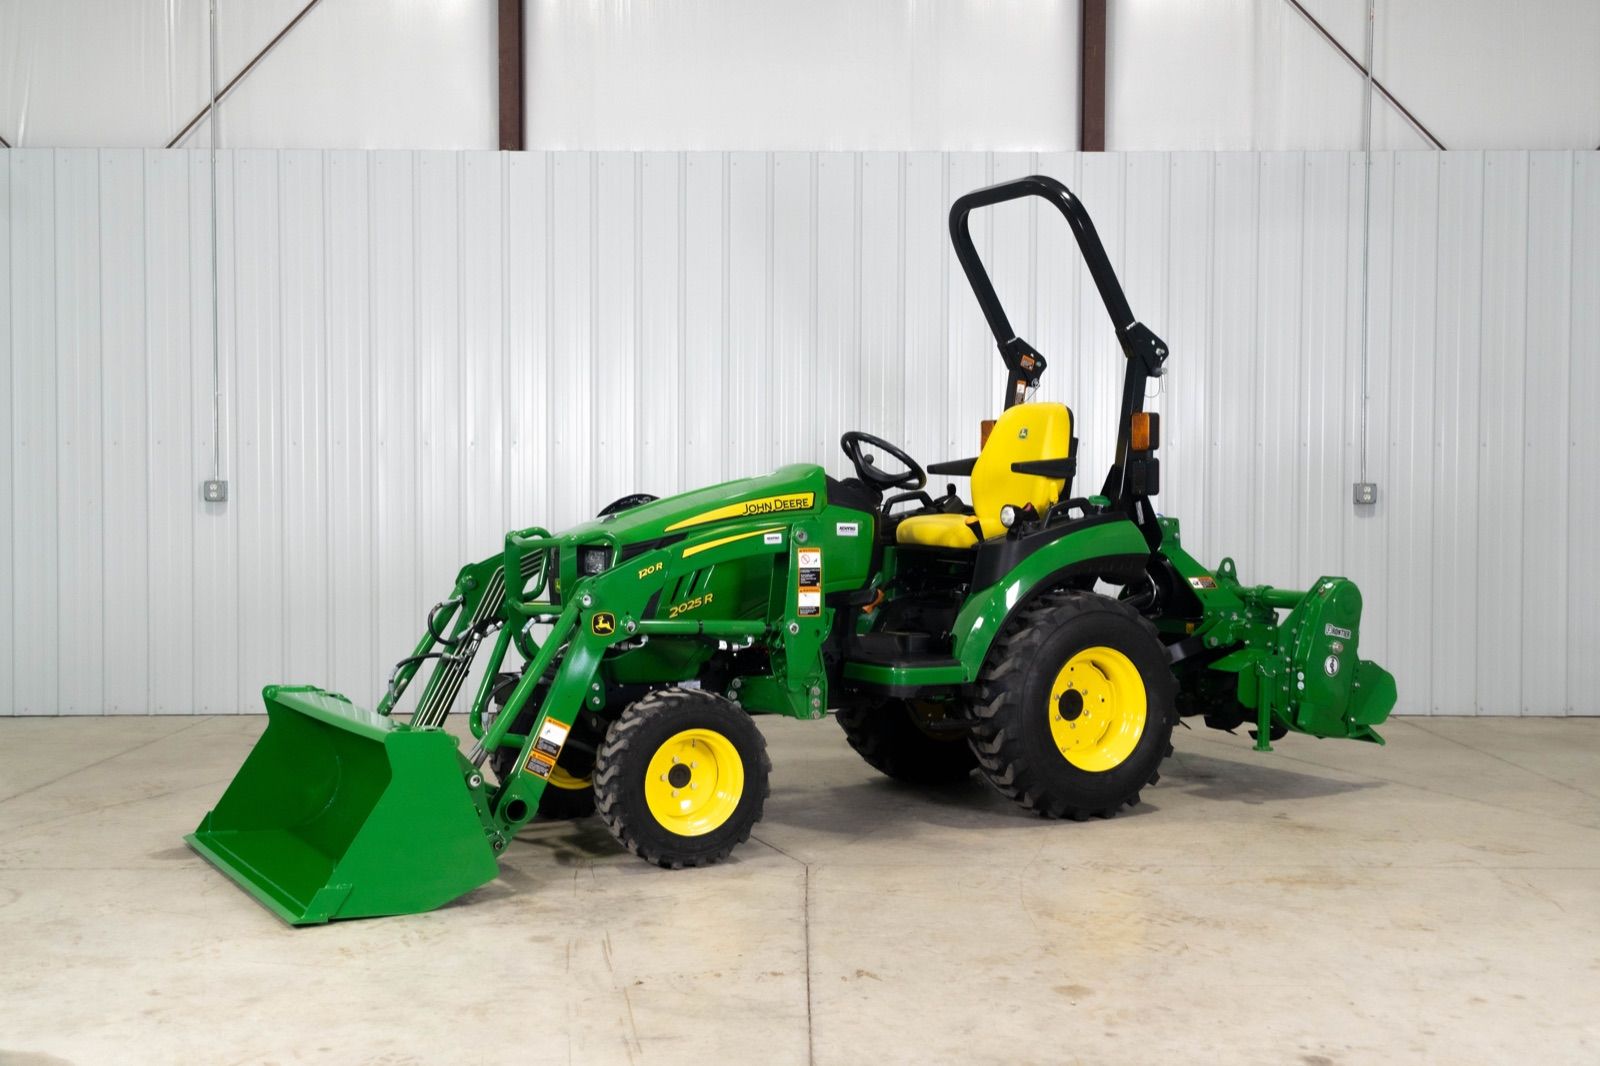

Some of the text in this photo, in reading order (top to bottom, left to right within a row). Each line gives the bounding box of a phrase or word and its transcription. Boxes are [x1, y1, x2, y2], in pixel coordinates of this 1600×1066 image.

[742, 498, 810, 515] JOHN DEERE
[638, 561, 663, 580] 120 R
[669, 593, 713, 618] 2025 R
